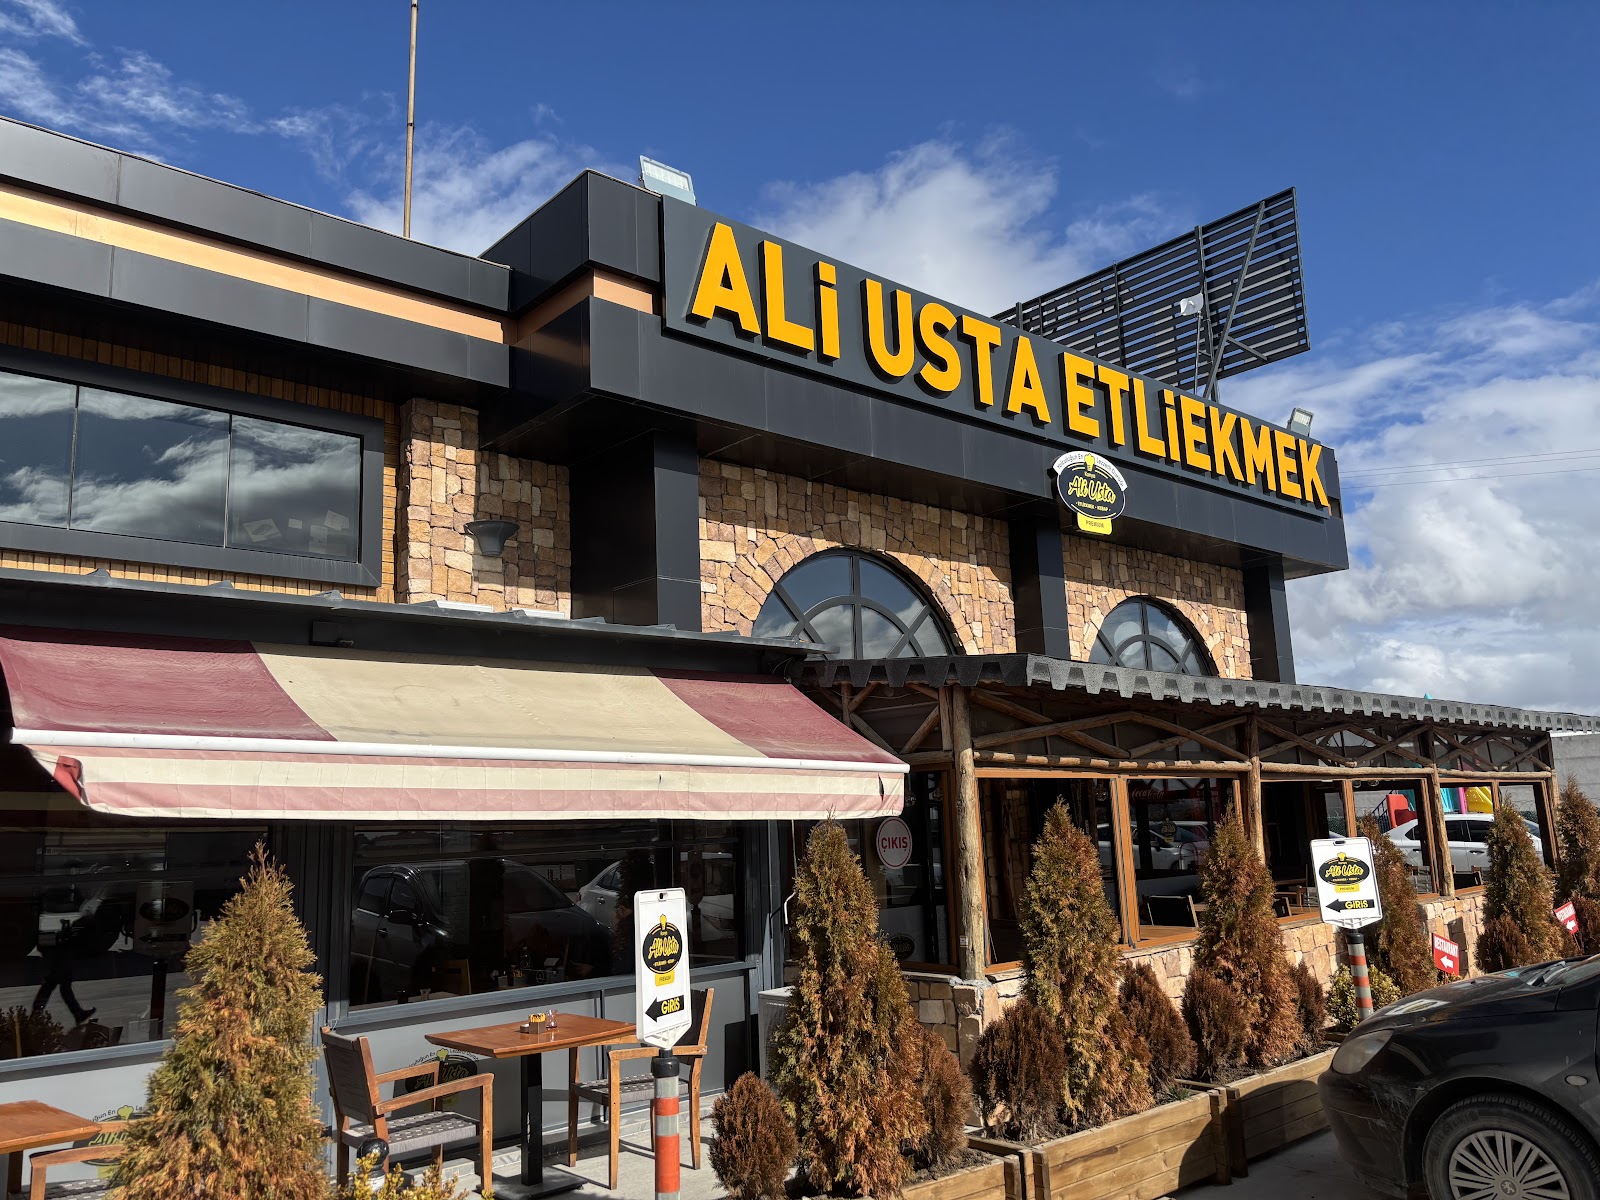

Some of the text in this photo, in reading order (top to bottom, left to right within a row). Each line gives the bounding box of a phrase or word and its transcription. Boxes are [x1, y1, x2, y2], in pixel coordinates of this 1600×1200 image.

[865, 278, 1051, 424] USTA
[1068, 475, 1116, 504] Ali Usta
